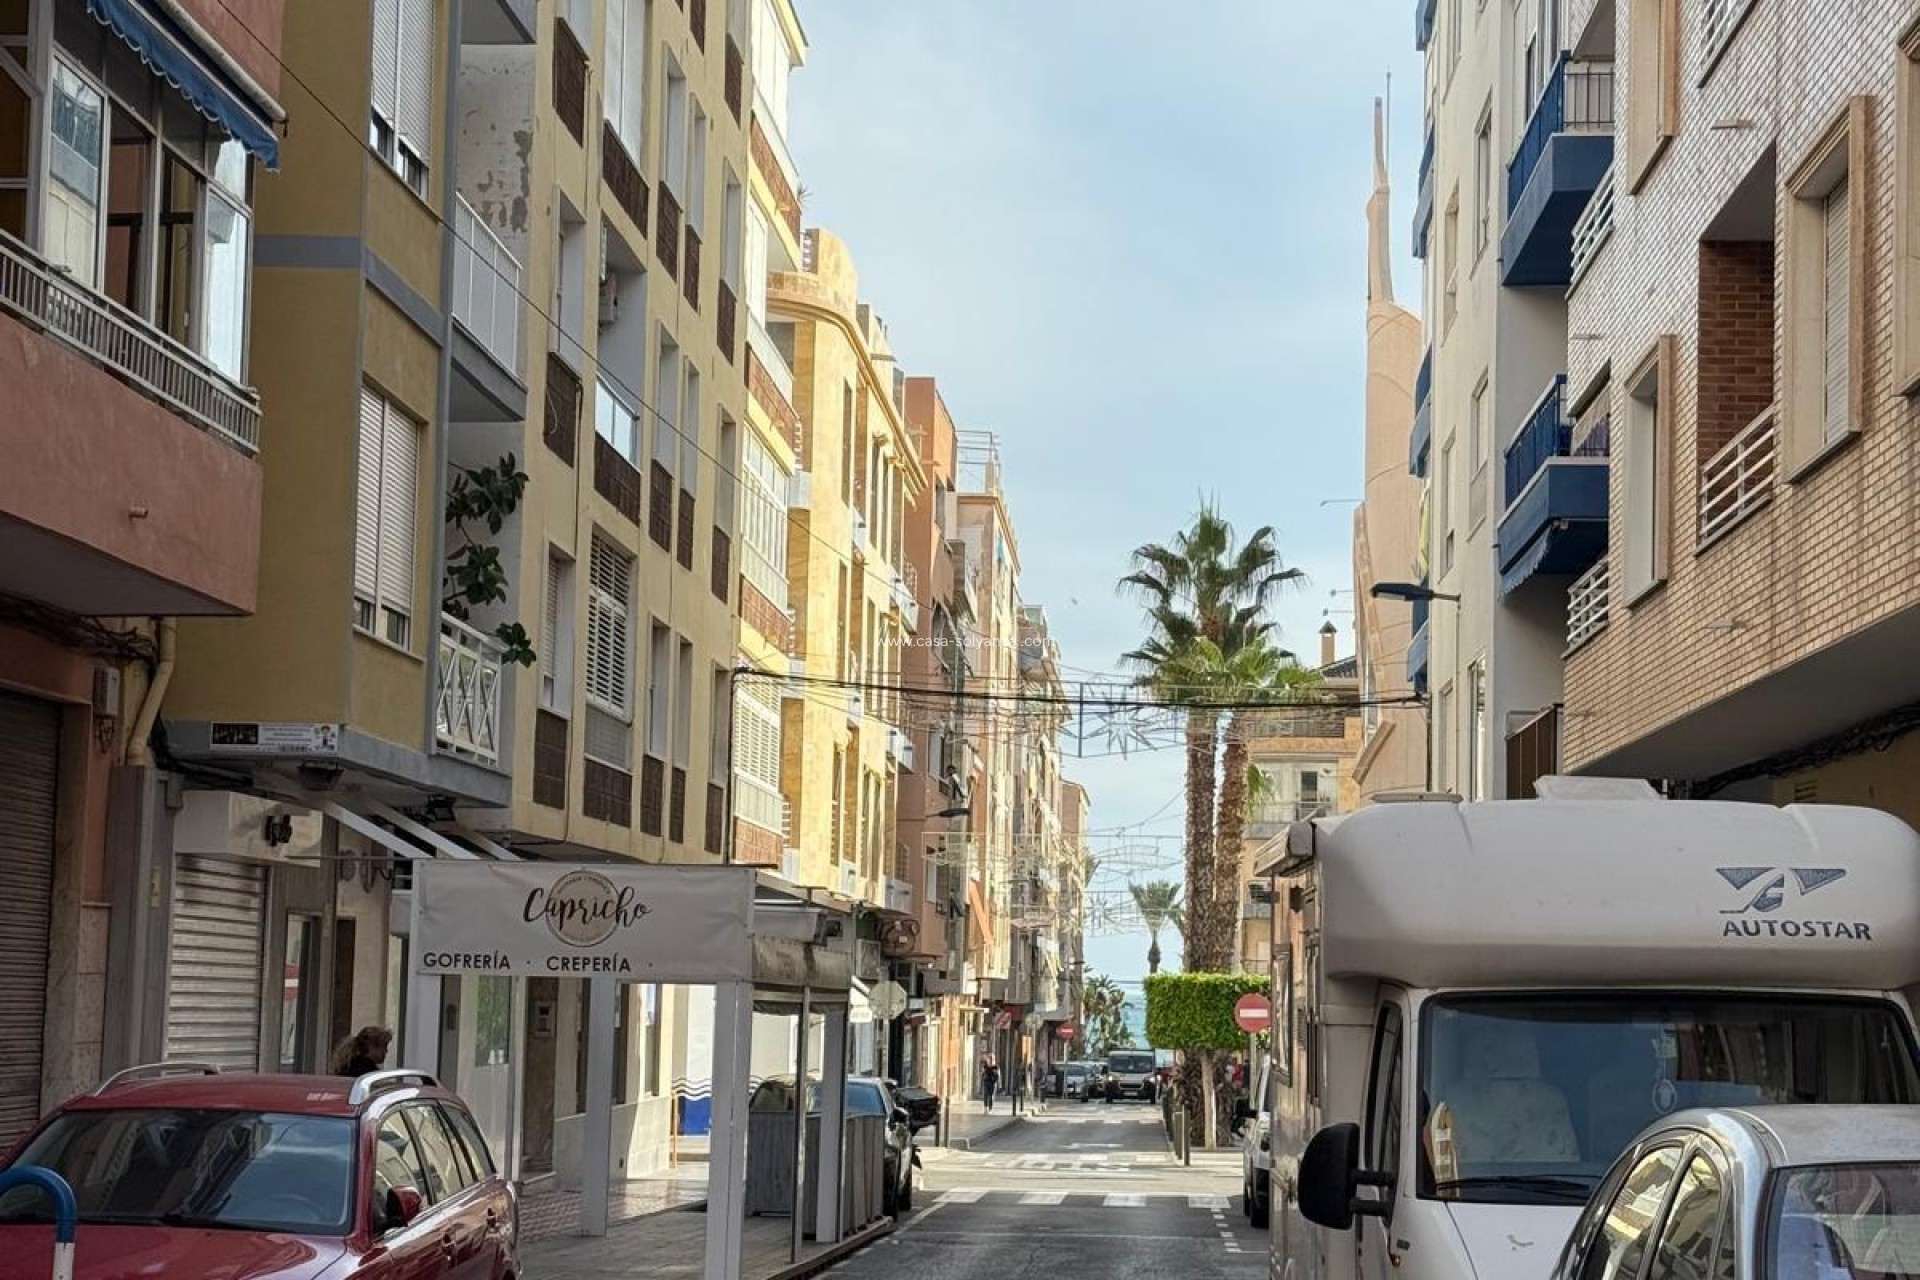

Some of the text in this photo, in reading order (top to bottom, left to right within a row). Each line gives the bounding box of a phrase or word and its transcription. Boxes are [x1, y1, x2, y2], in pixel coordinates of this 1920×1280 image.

[523, 886, 653, 931] Capricho
[1723, 919, 1873, 940] AUTOSTAR
[423, 950, 631, 972] GOFRERÍA CREPERÍA
